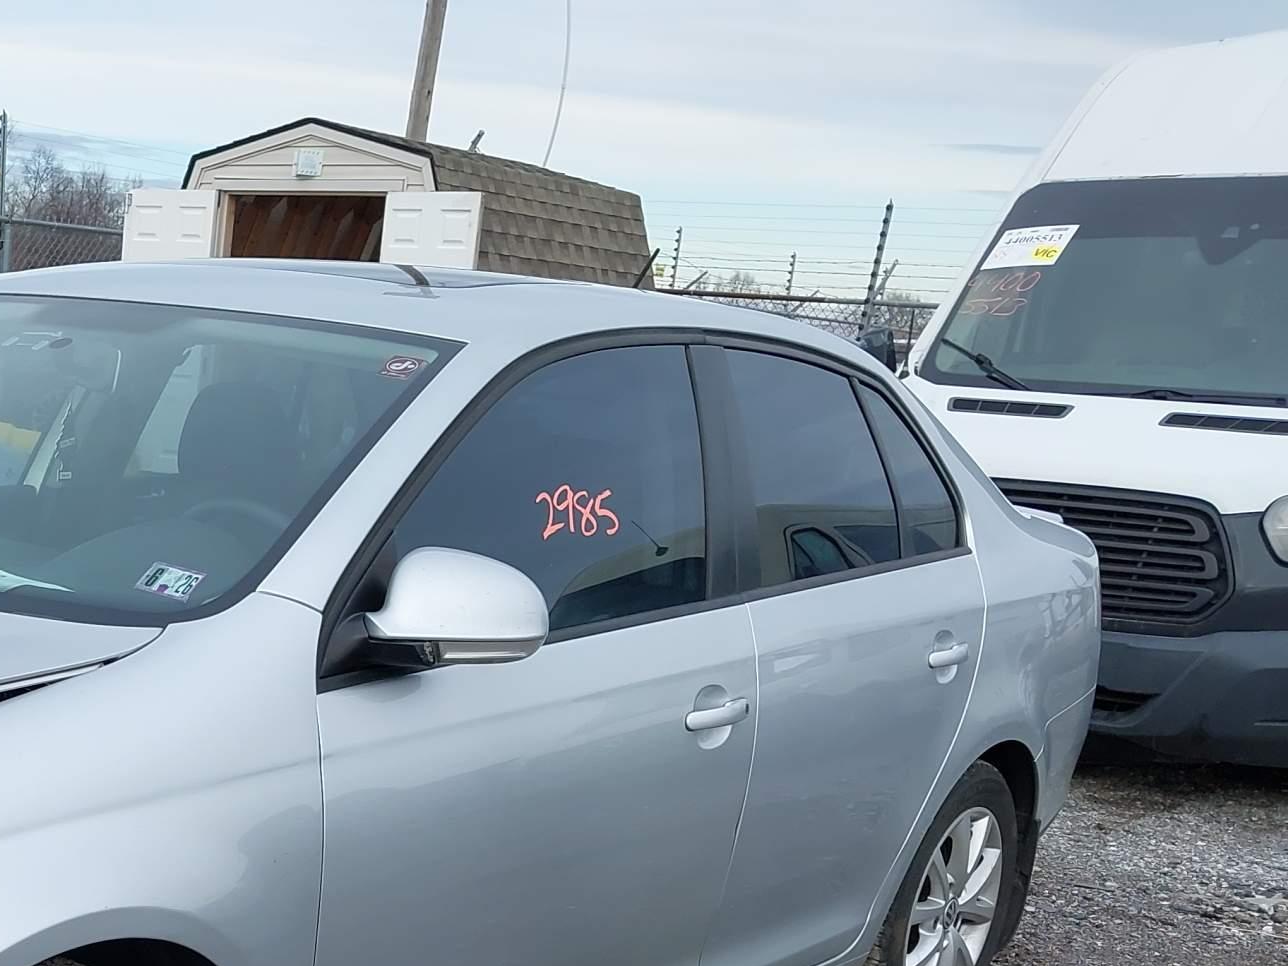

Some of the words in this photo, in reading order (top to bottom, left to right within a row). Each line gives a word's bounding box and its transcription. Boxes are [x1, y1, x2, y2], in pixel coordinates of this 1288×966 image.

[1034, 248, 1057, 258] VIC
[535, 484, 620, 540] 2985
[144, 567, 165, 587] 6
[174, 575, 199, 595] 26
